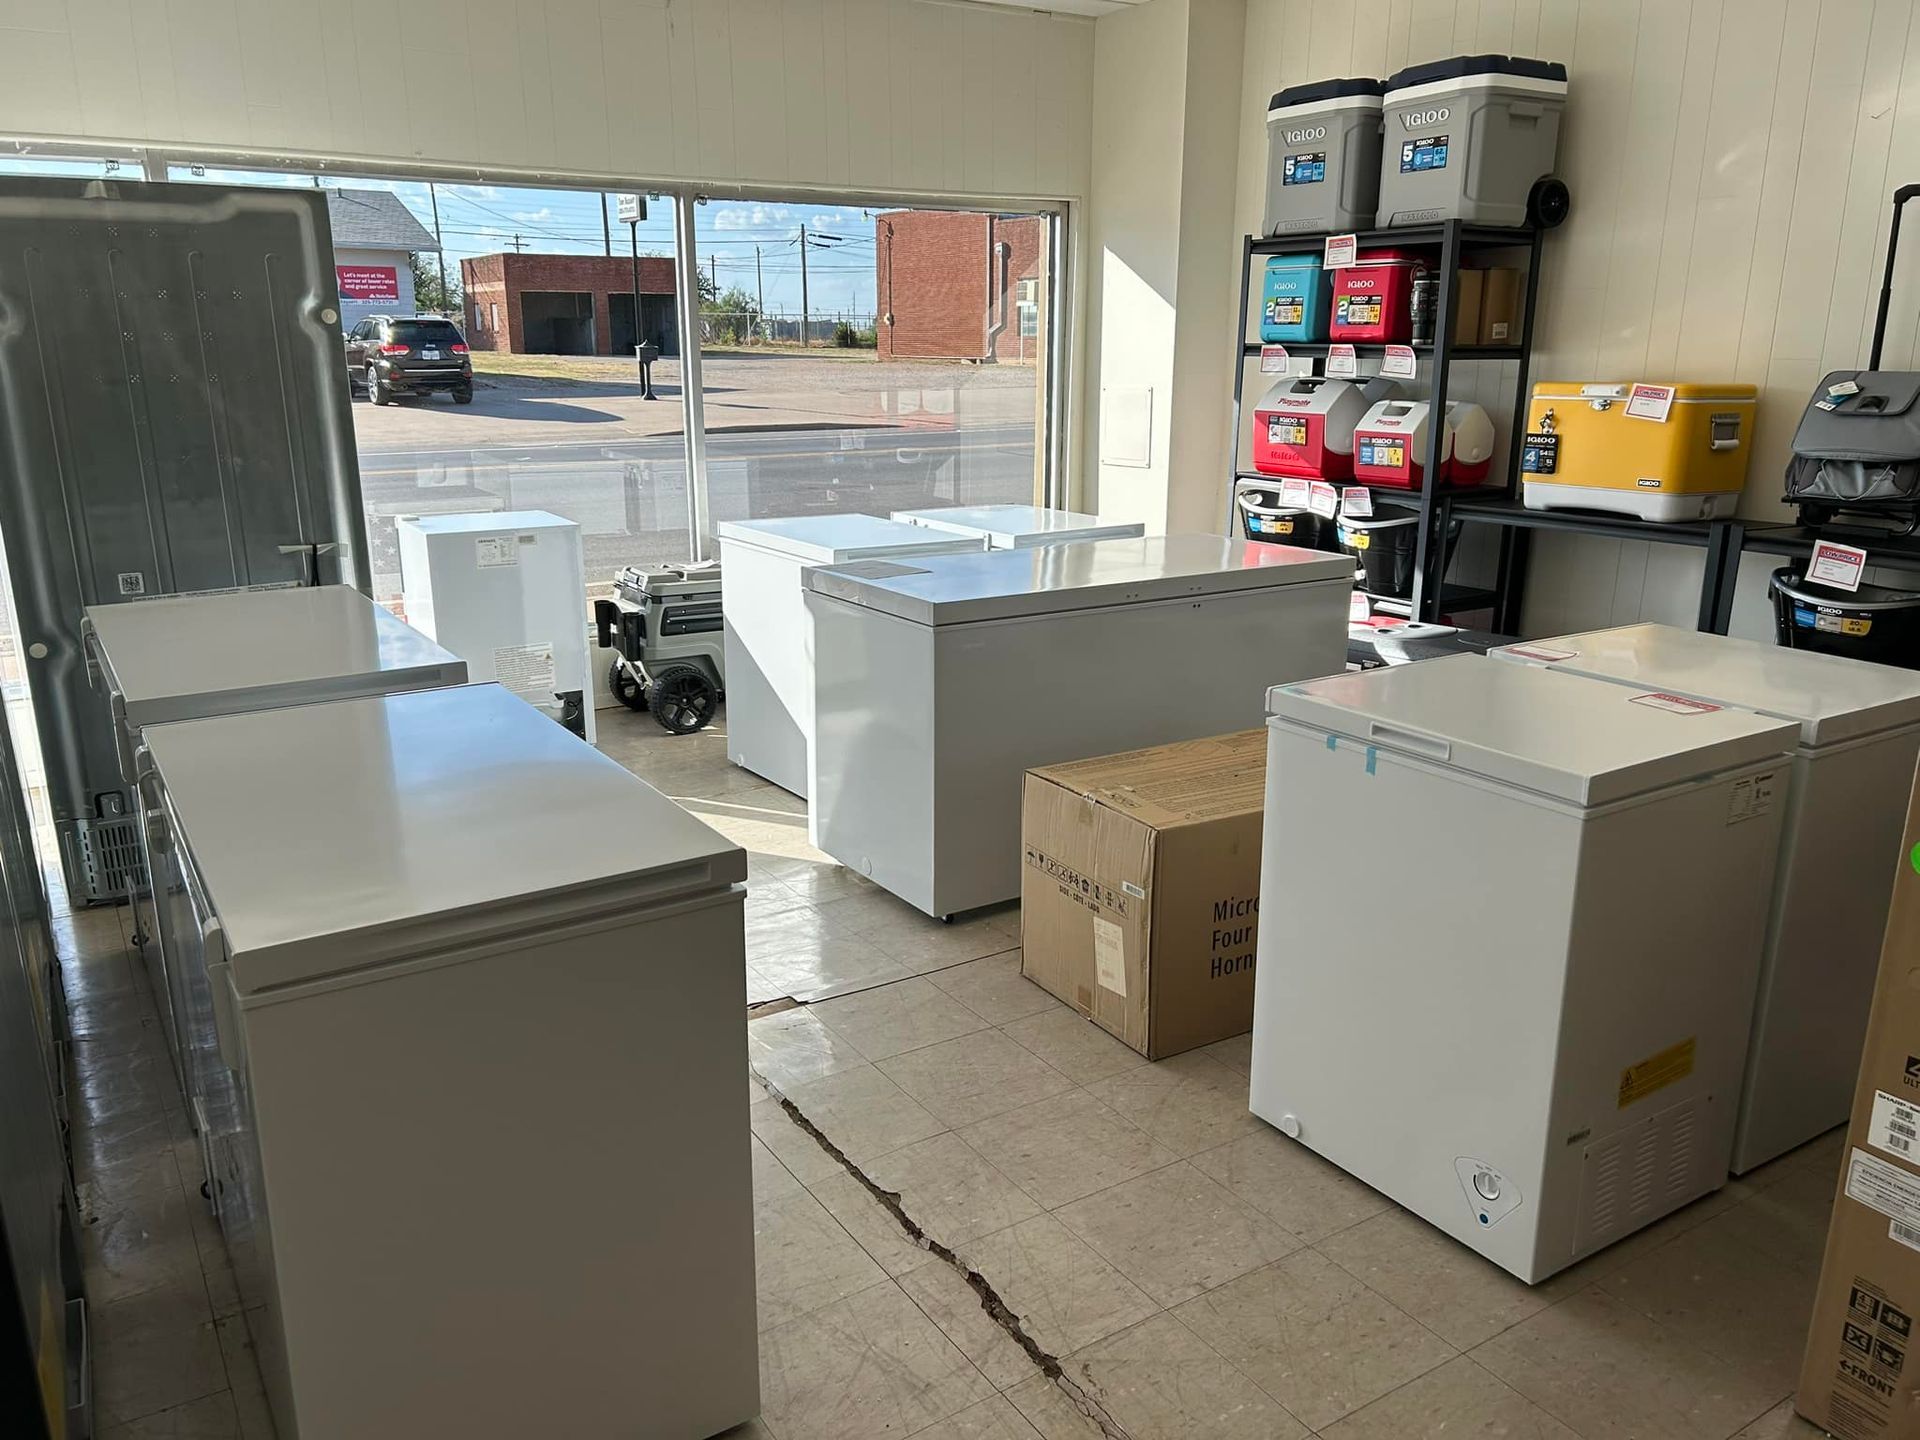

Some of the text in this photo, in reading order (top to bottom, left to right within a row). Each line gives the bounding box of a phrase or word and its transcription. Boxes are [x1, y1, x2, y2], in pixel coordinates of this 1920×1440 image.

[1406, 108, 1450, 127] IGLOO
[1287, 126, 1326, 143] IGLOO
[1415, 138, 1435, 146] IGLOO
[1402, 144, 1414, 162] 5
[1285, 159, 1295, 175] 5
[1273, 282, 1297, 291] IGLOO
[1347, 279, 1375, 289] IGLOO
[1265, 302, 1275, 316] 2
[1337, 301, 1348, 315] 2
[1277, 397, 1311, 407] Playmate
[1279, 416, 1298, 424] IGLOO
[1374, 418, 1402, 427] Playmate
[1371, 437, 1392, 445] IGLOO
[1527, 436, 1556, 444] IGLOO
[1525, 450, 1537, 464] 4
[1818, 605, 1842, 615] IGLOO
[1212, 925, 1253, 951] Four
[1850, 1365, 1896, 1398] FRONT
